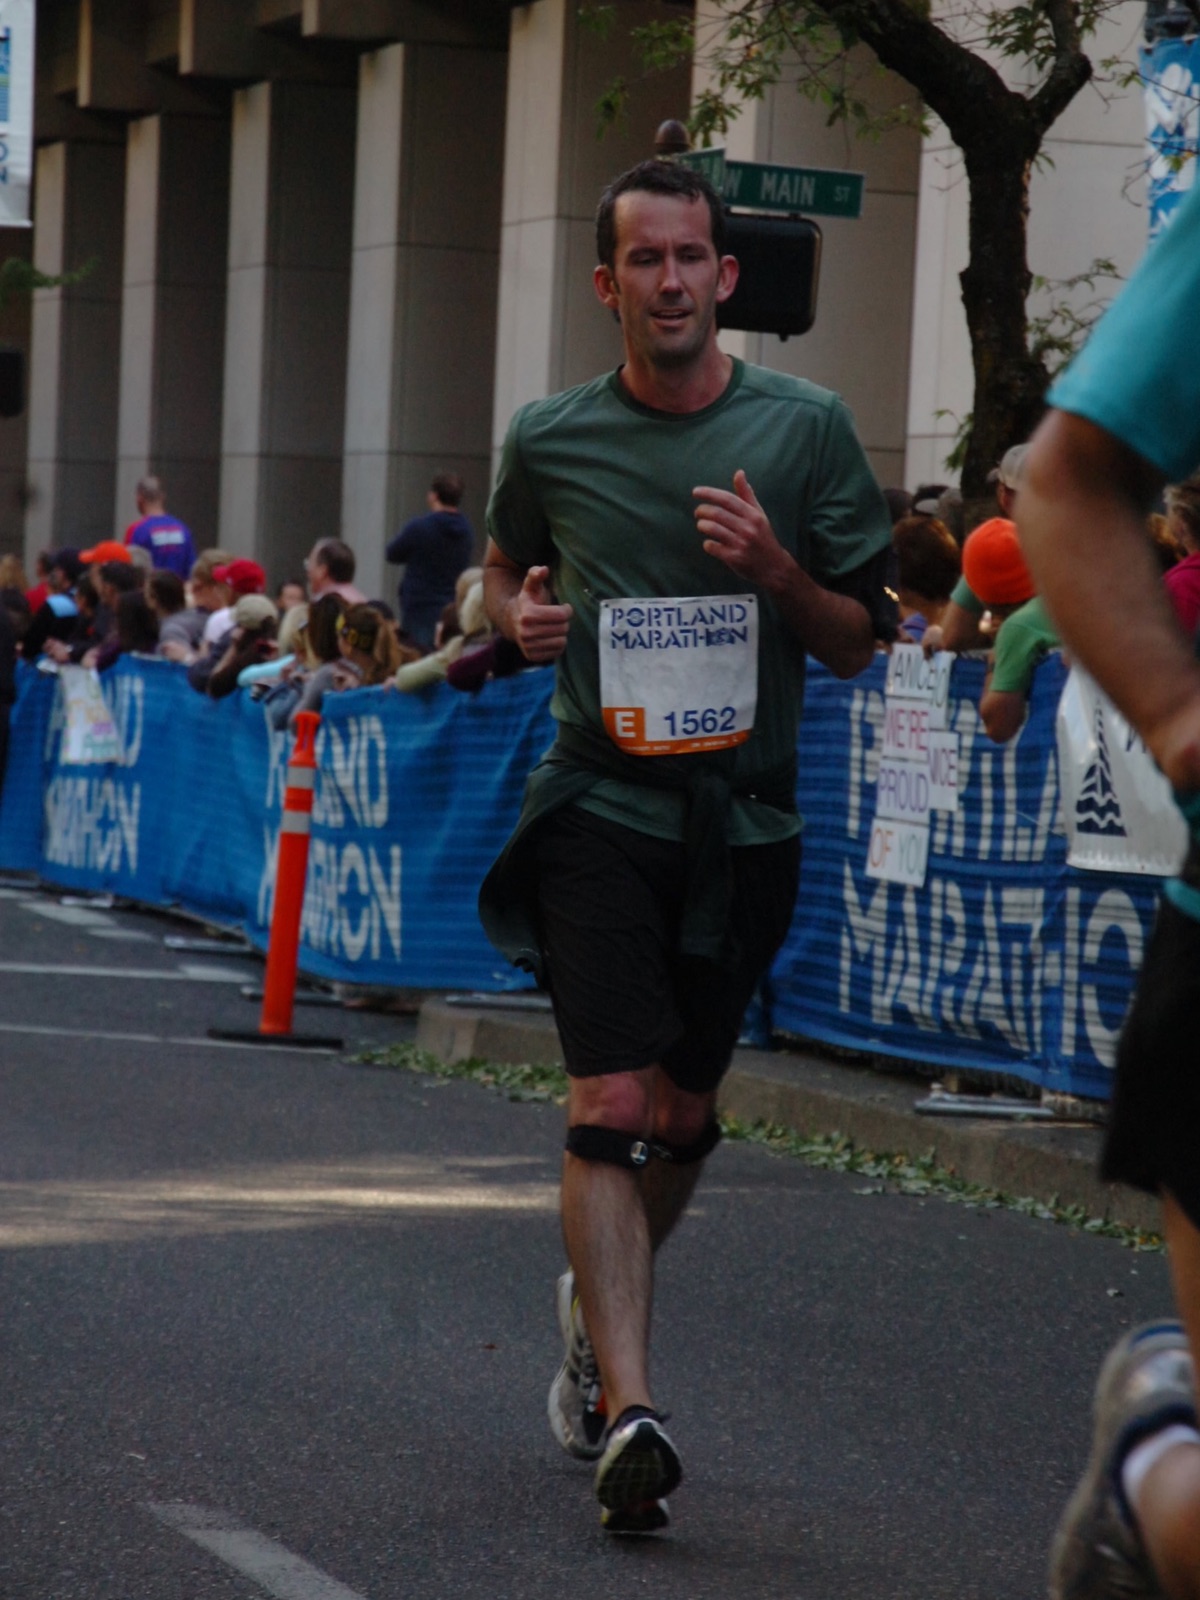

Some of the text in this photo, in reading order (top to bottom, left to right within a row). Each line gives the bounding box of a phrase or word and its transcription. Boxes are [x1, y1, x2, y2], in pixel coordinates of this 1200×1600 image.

[760, 171, 816, 206] MAIN
[834, 185, 851, 203] ST
[611, 603, 747, 627] PORTLAND
[611, 625, 748, 649] MARATHON
[614, 711, 636, 737] E
[663, 706, 737, 737] 1562
[878, 767, 929, 813] PROUD
[838, 856, 1143, 1069] MARATHO
